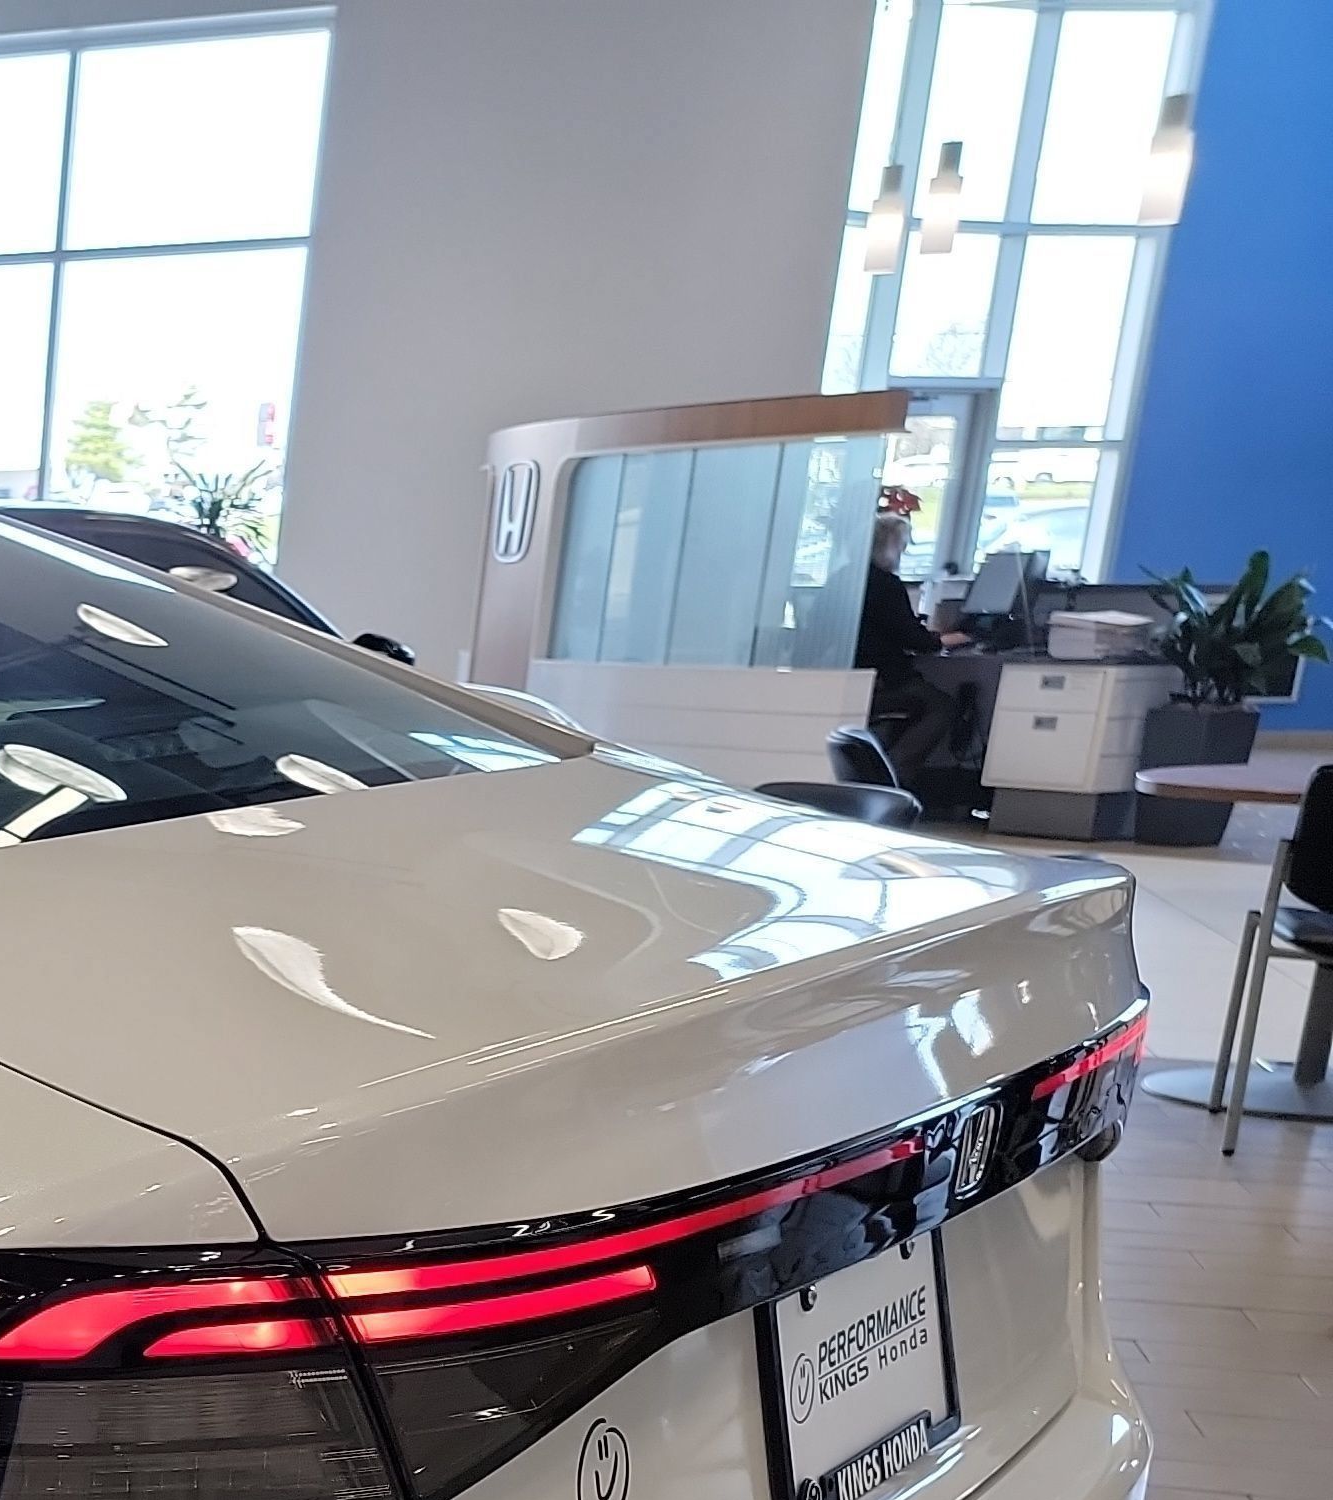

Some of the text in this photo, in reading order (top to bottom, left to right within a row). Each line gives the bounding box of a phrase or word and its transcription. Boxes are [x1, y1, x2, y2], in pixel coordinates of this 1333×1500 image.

[818, 1285, 926, 1375] PERFORMANCE
[818, 1328, 928, 1404] KINGS Honda
[882, 1419, 929, 1479] HONDA
